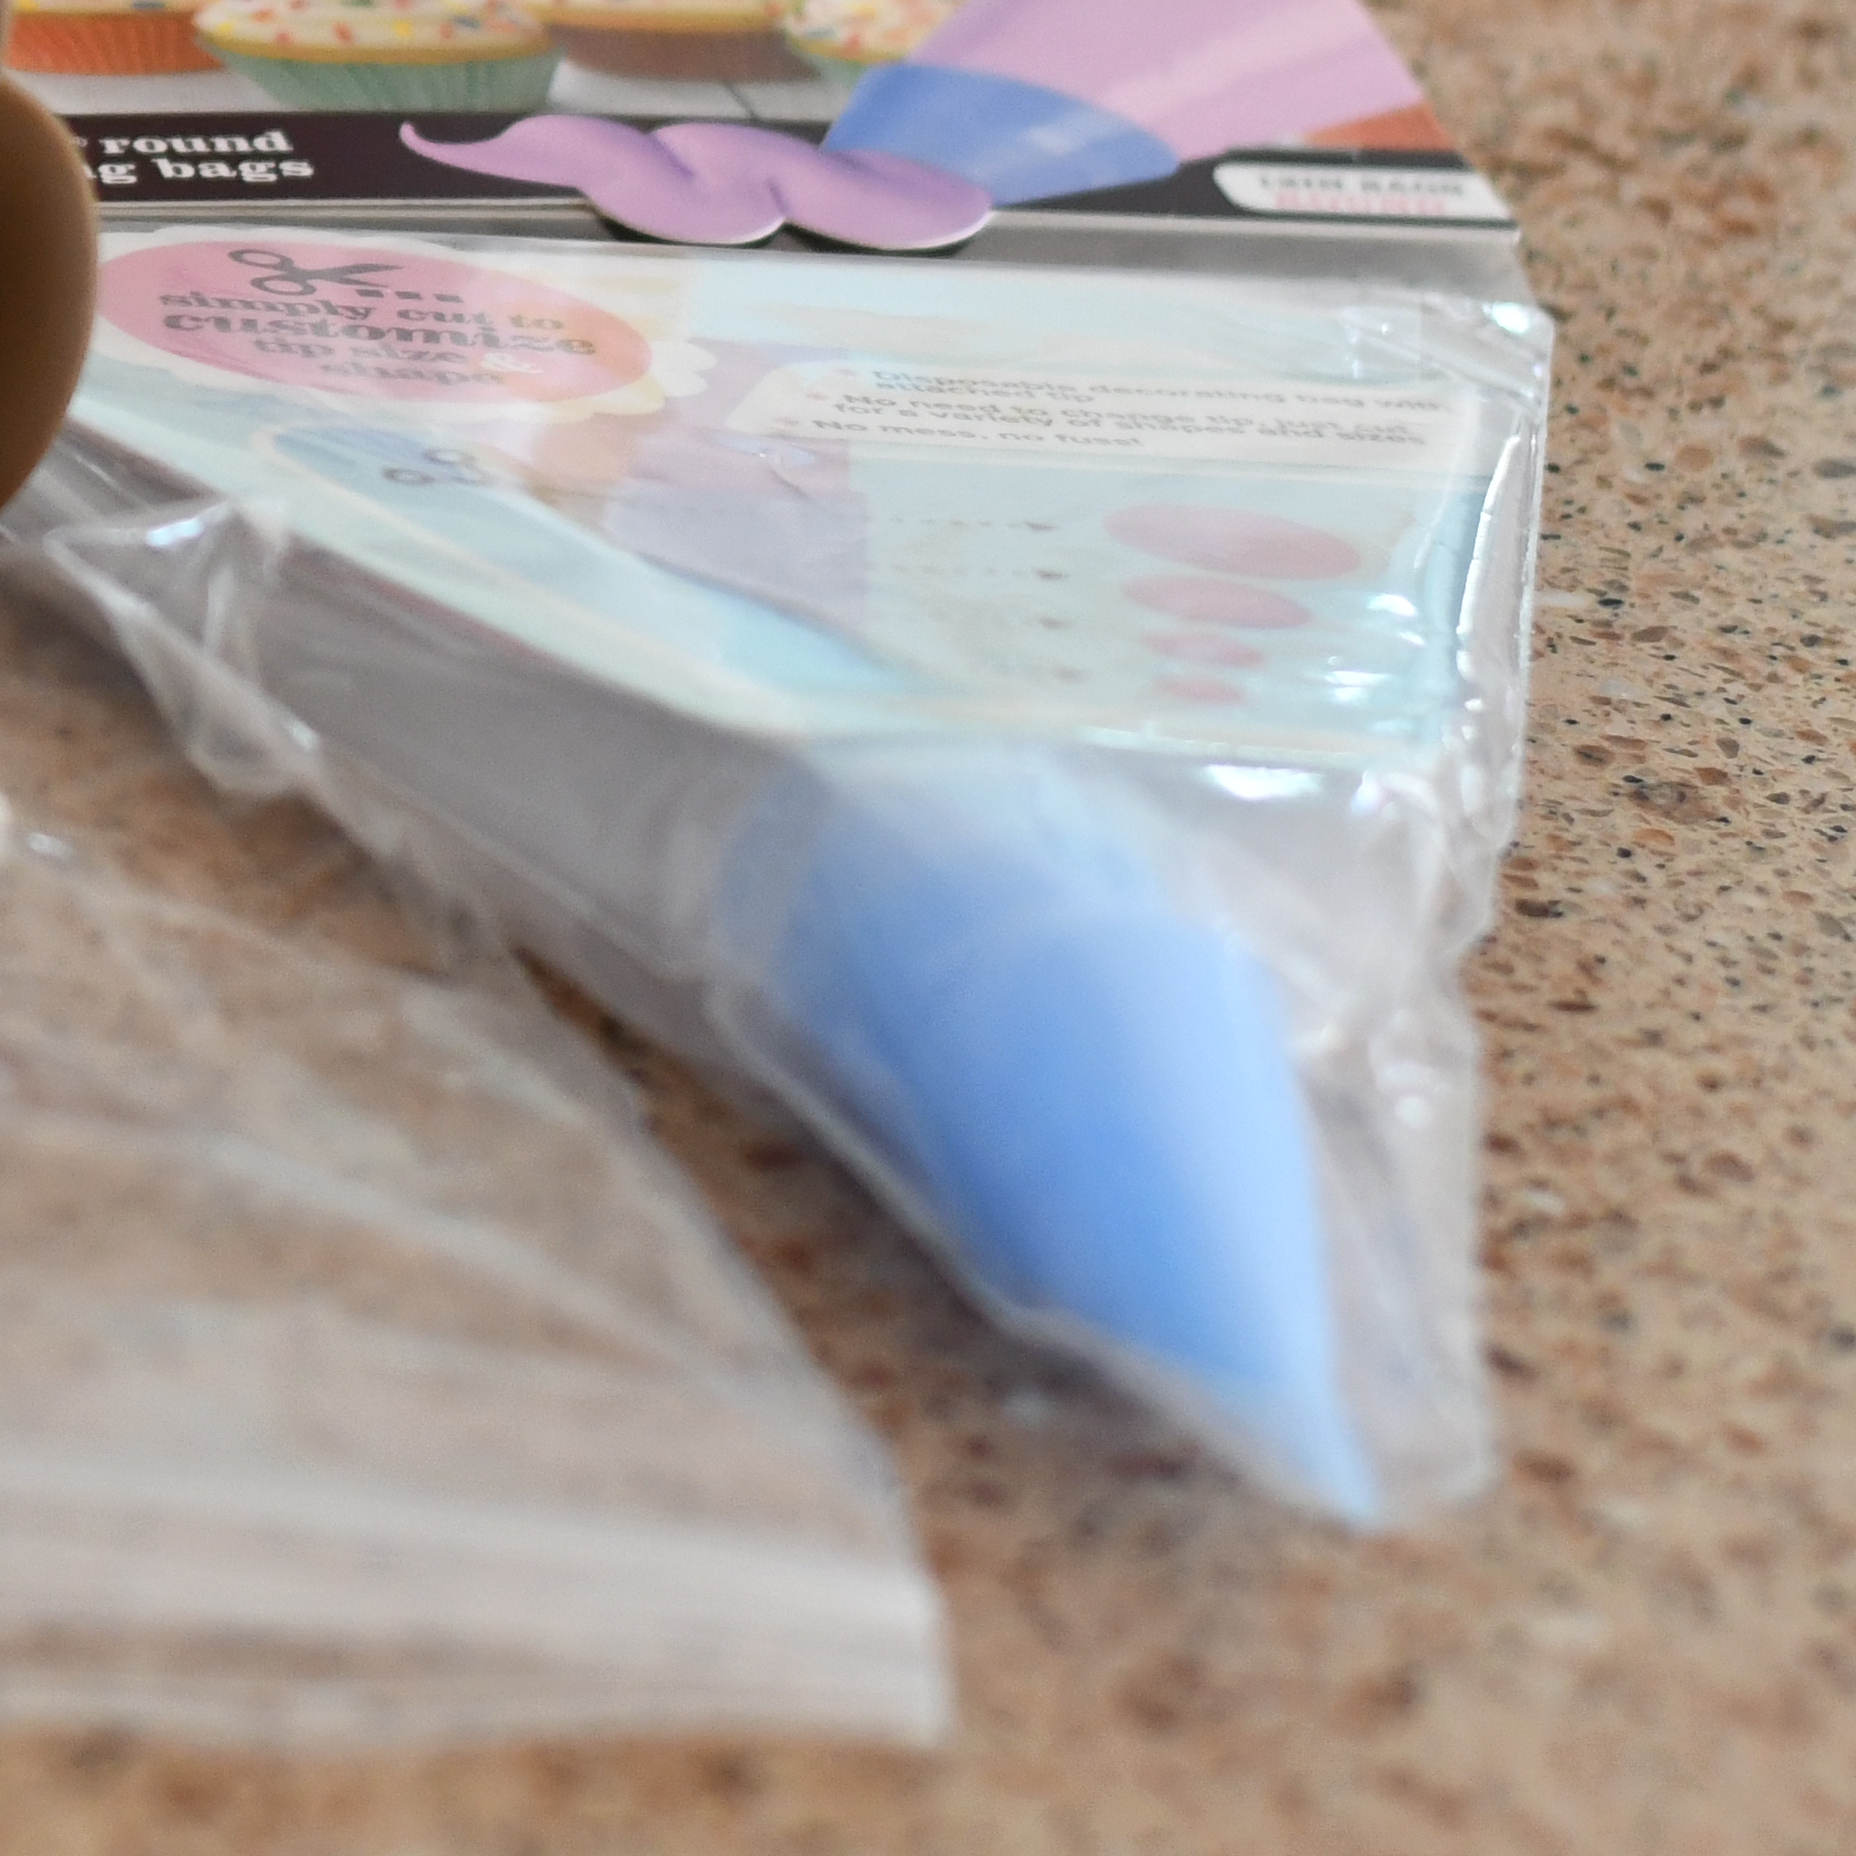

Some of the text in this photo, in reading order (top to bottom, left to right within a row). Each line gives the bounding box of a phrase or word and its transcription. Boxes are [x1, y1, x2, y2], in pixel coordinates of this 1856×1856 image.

[98, 130, 294, 154] round
[150, 158, 315, 184] bags
[159, 290, 566, 331] simply cut to
[163, 313, 596, 356] customize
[254, 337, 336, 359] tip
[872, 370, 1078, 391] Disposable
[1089, 384, 1285, 404] decorating
[834, 403, 885, 416] for
[842, 394, 897, 406] No
[909, 400, 1001, 414] need
[1009, 405, 1048, 416] to
[812, 419, 869, 432] No
[998, 431, 1045, 442] no
